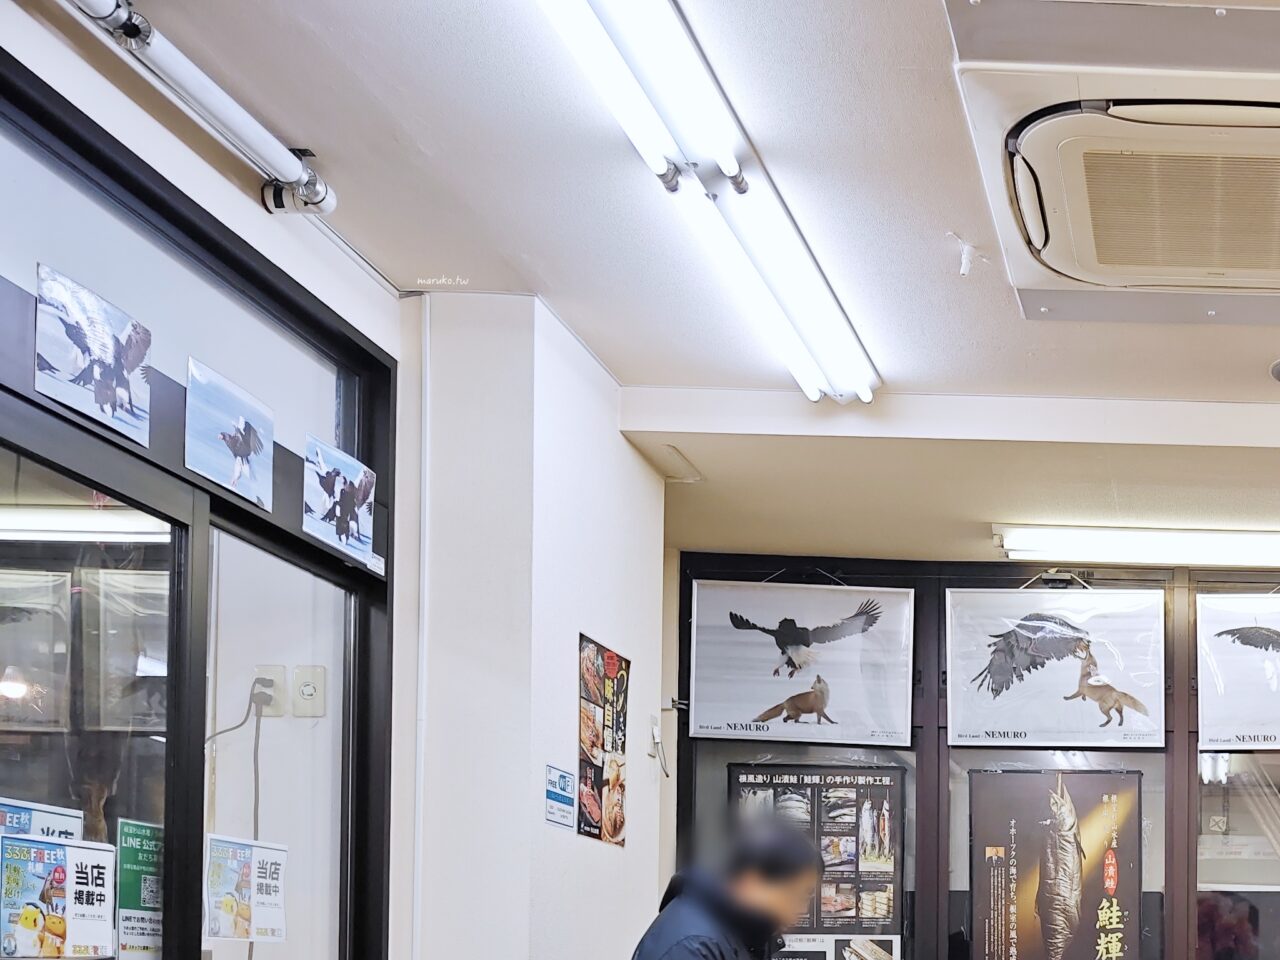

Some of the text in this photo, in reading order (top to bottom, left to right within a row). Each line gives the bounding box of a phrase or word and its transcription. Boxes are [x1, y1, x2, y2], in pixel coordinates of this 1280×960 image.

[726, 722, 769, 732] NEMURO
[984, 730, 1027, 739] NEMURO
[1235, 735, 1277, 743] NEMURO
[122, 836, 141, 848] LINE
[75, 861, 106, 888] 当店
[257, 859, 281, 881] 当店
[256, 883, 280, 897] 掲載中
[73, 889, 106, 907] 掲載中
